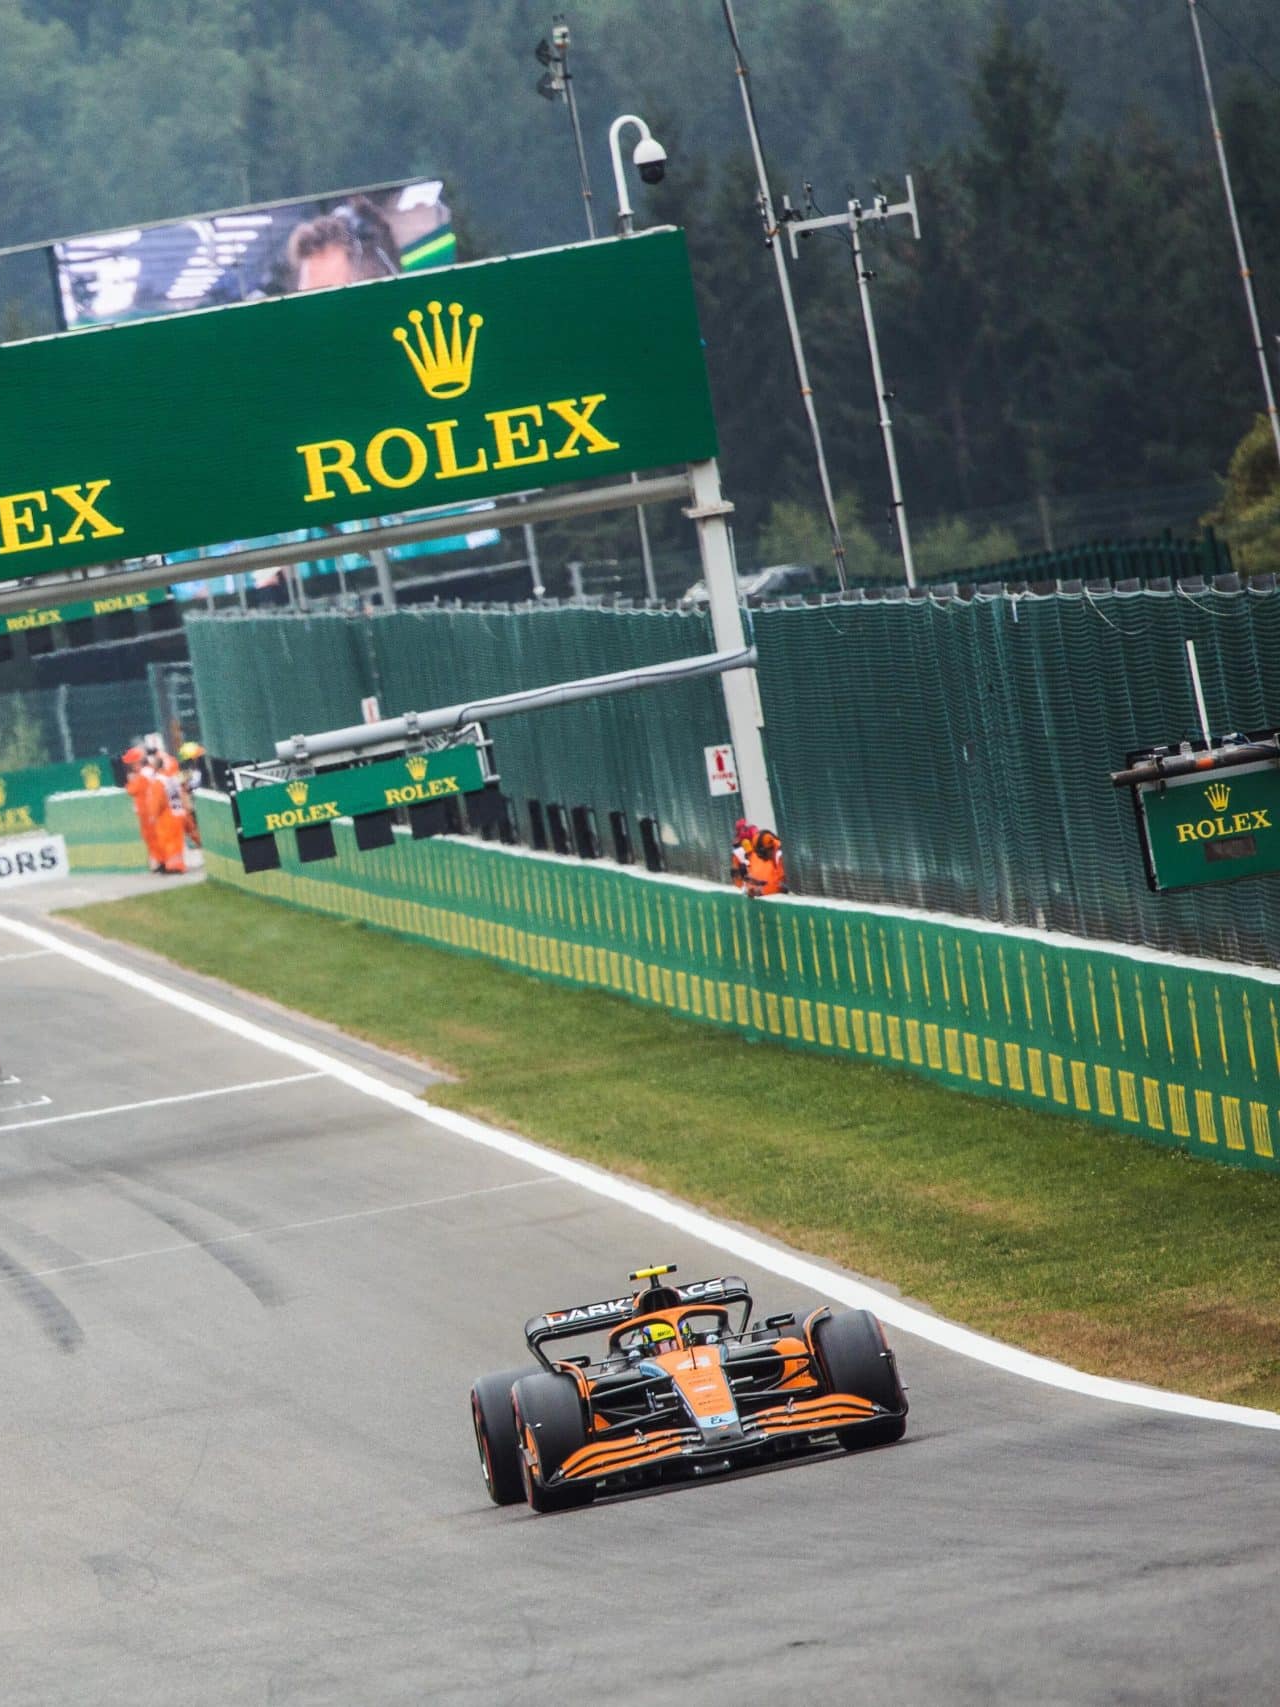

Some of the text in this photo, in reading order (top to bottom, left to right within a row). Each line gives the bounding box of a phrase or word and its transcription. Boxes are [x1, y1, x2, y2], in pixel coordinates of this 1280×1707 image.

[296, 393, 619, 502] ROLEX
[91, 591, 148, 614] ROLEX
[6, 608, 62, 632] ROLEX
[384, 776, 460, 806] ROLEX
[265, 801, 341, 831] ROLEX
[1176, 809, 1272, 843] ROLEX
